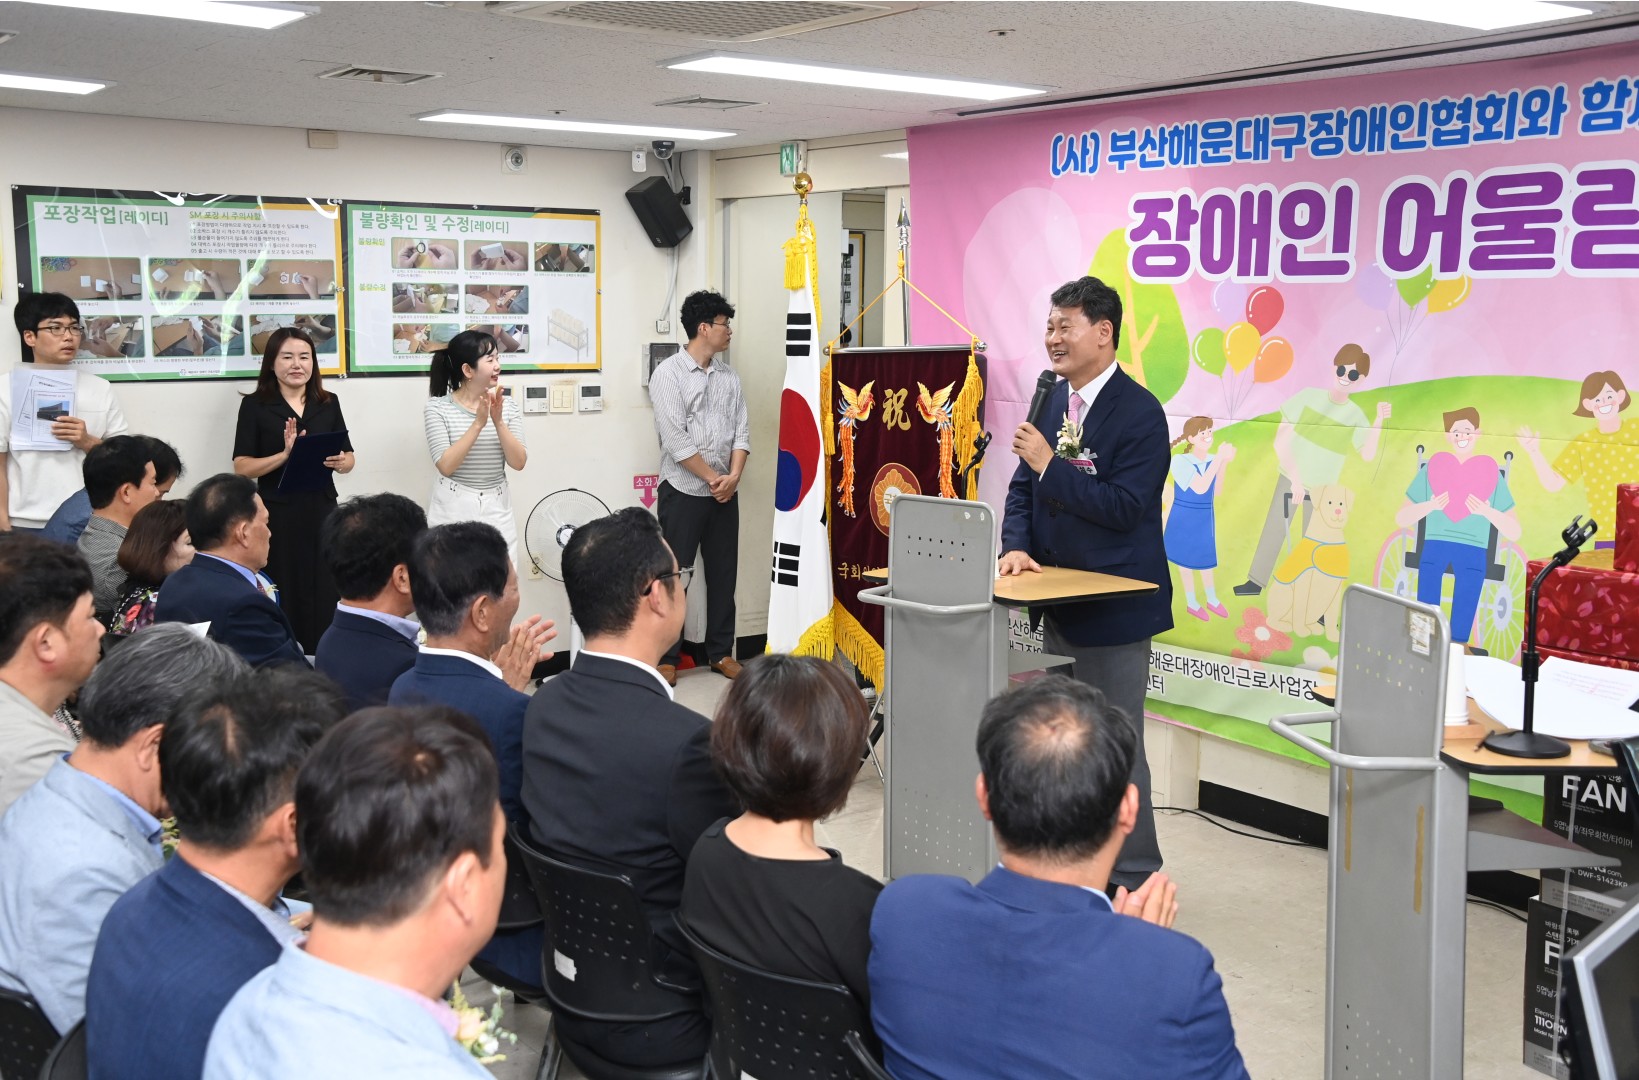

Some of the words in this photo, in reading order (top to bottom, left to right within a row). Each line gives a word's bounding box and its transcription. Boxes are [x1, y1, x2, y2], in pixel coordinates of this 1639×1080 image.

[1050, 133, 1100, 176] (사)
[1107, 85, 1568, 172] 부산해운대구장애인협회와
[1581, 78, 1639, 134] 함
[359, 212, 418, 231] 불량확인
[424, 215, 438, 231] 및
[1128, 184, 1355, 279] 장애인
[883, 387, 912, 431] 祝
[1562, 775, 1627, 813] FAN
